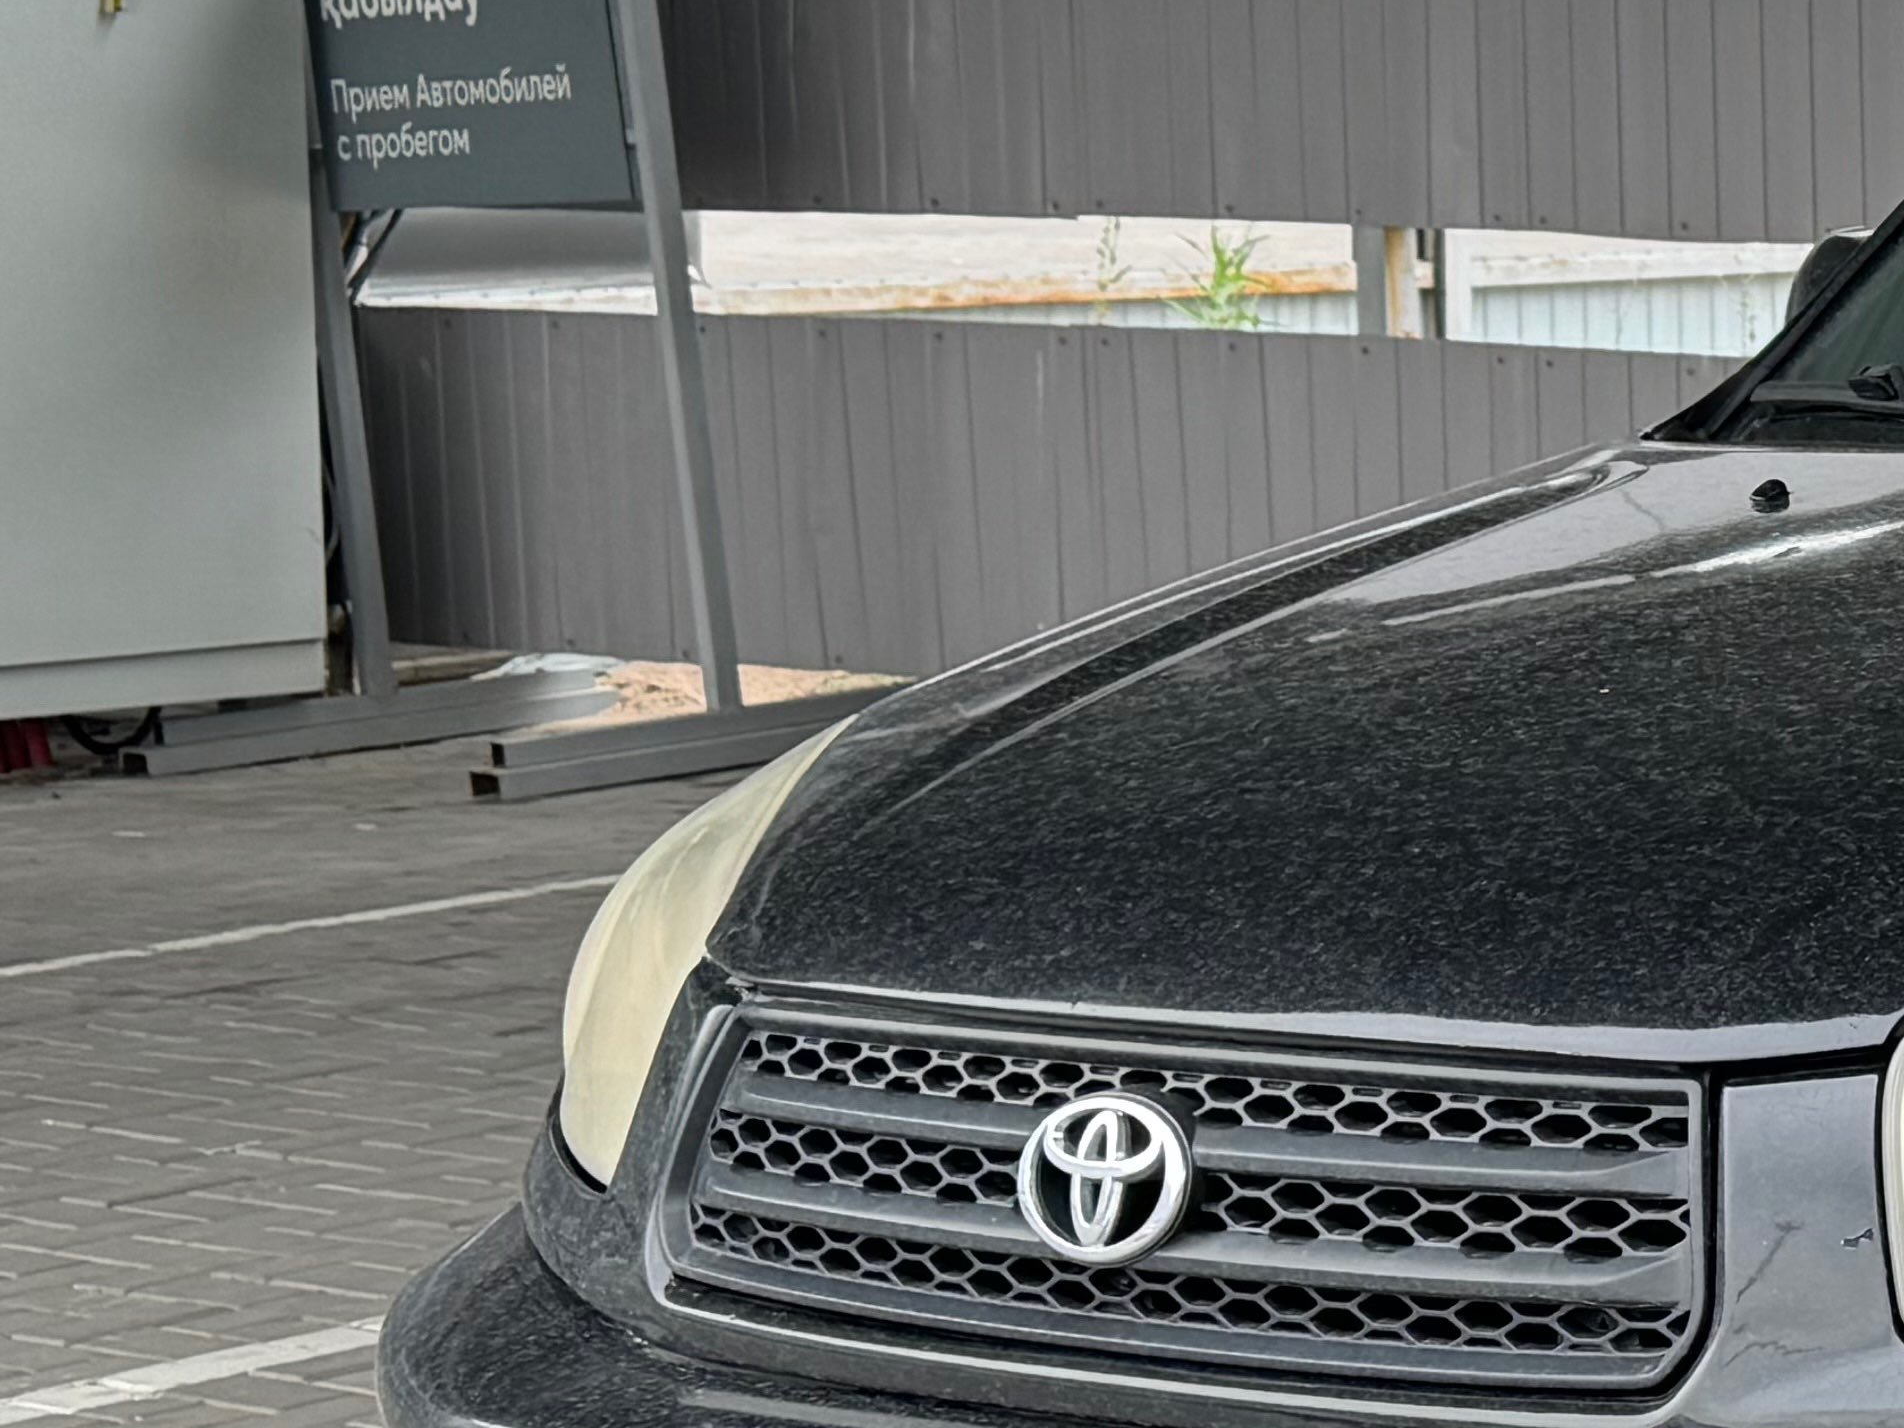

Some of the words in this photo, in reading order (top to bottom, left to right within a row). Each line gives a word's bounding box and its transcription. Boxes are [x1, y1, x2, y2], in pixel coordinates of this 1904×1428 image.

[330, 79, 409, 123] Прием
[416, 63, 572, 109] Автомобилей
[337, 134, 352, 161] с
[357, 121, 470, 170] пробегом
